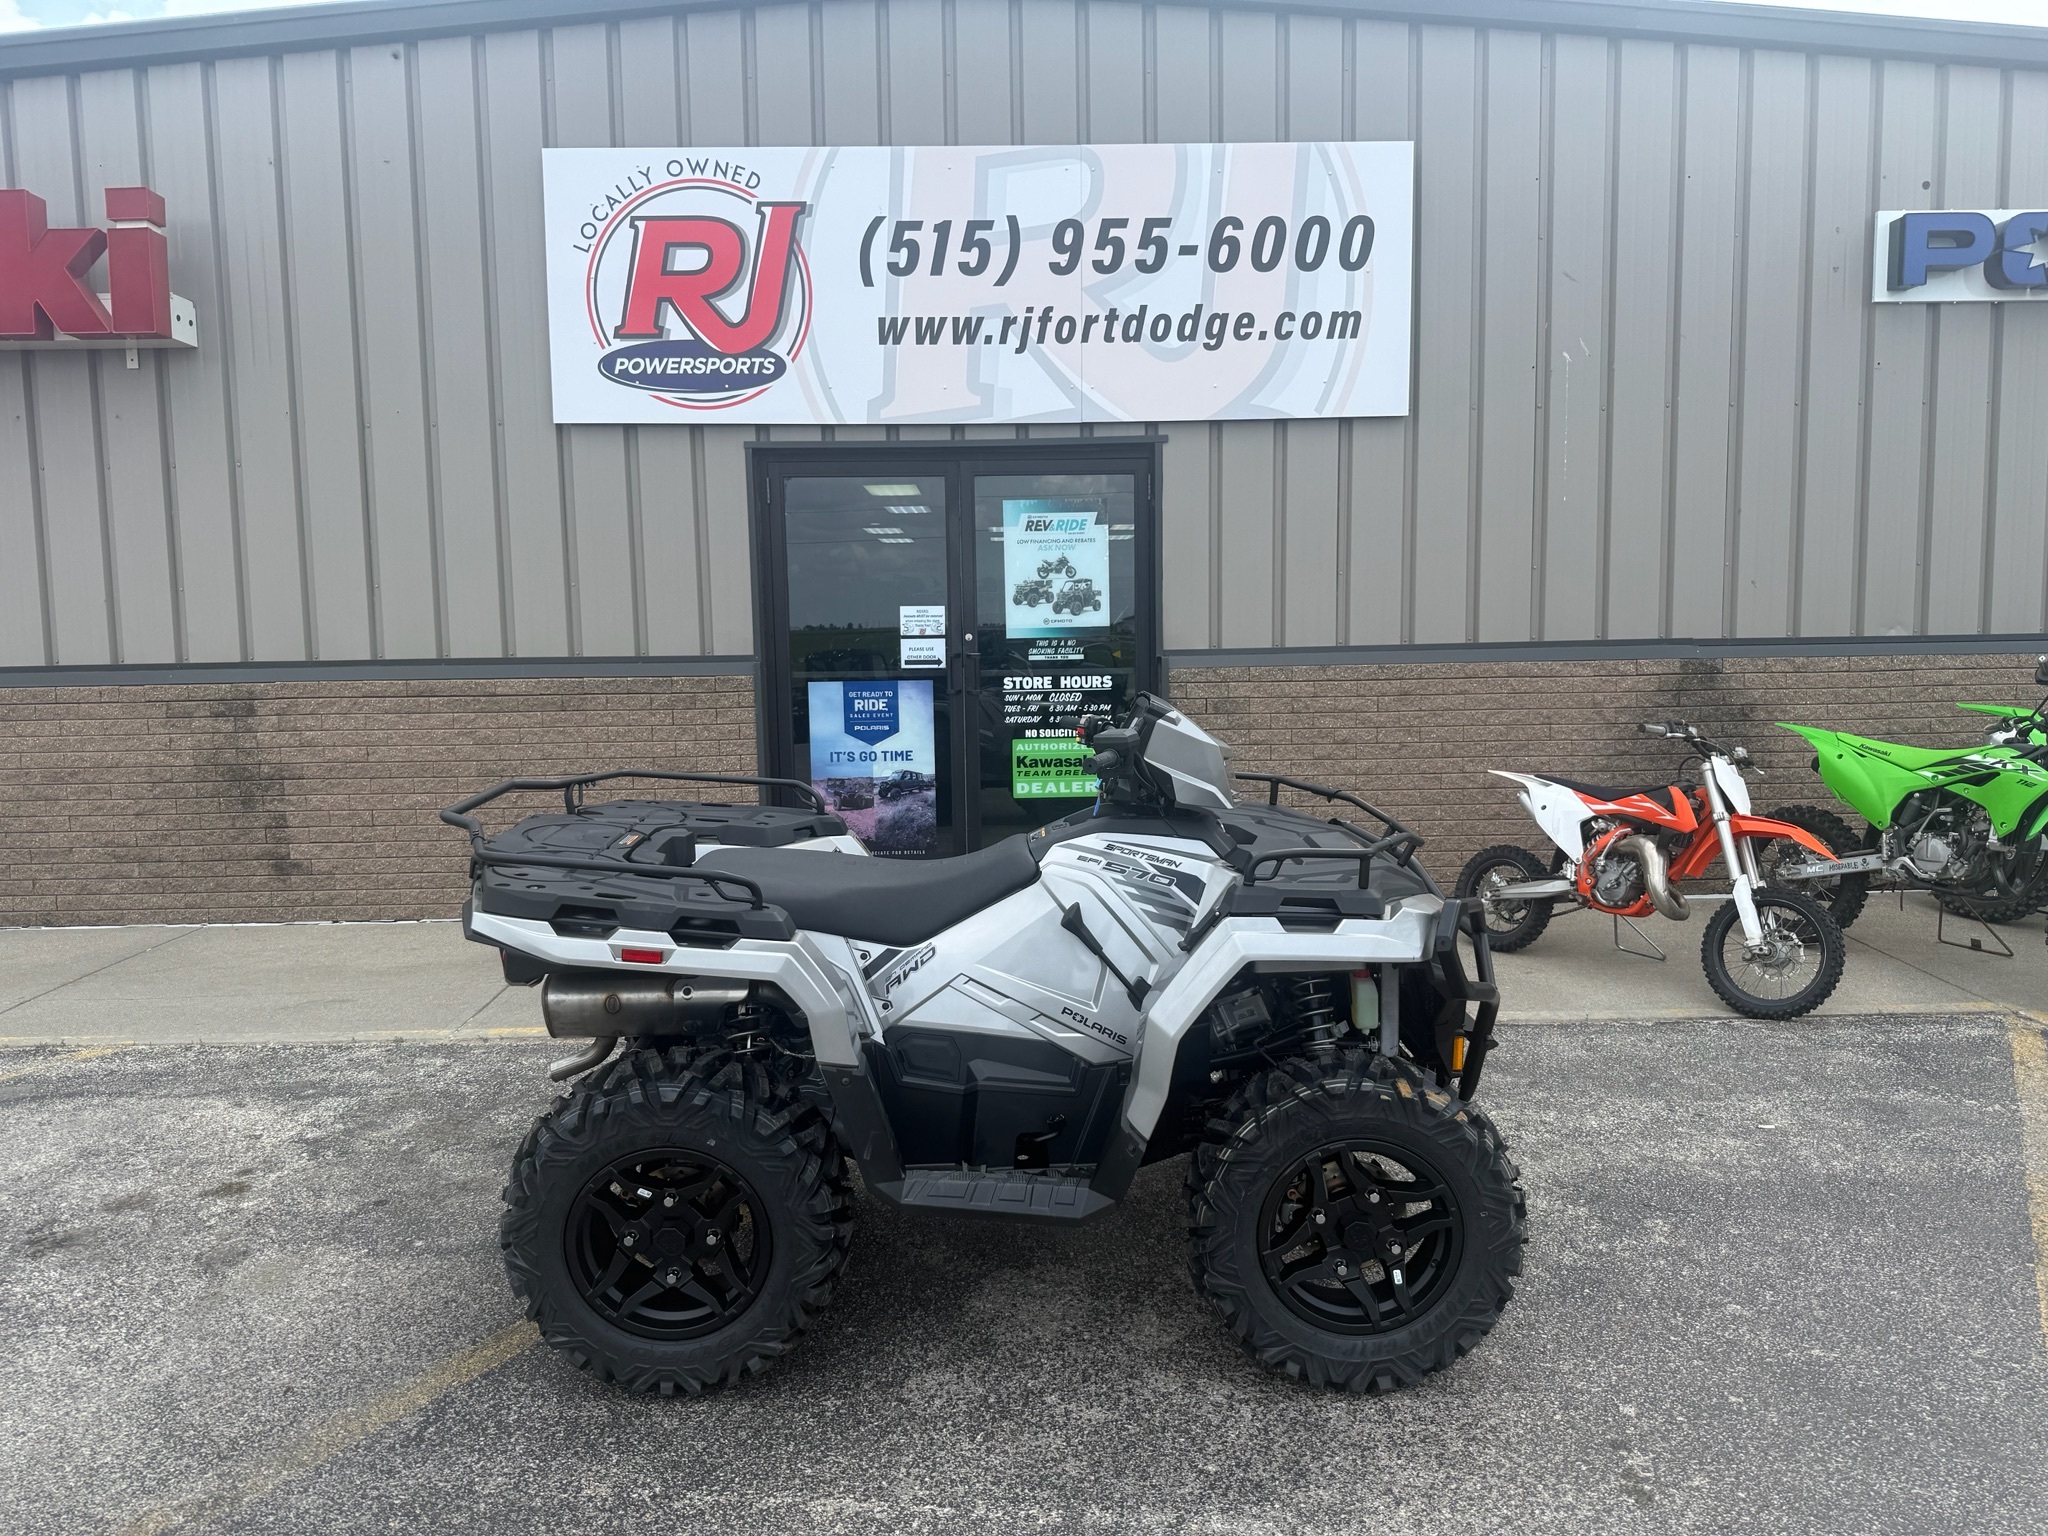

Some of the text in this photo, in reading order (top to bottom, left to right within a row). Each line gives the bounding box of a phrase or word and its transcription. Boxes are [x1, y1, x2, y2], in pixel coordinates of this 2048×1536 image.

[573, 157, 761, 253] LOCALLY OWNED
[859, 214, 1375, 287] (515) 955-6000
[0, 187, 172, 340] ki
[613, 201, 808, 354] RJ
[877, 303, 1362, 354] www.rjfortdodge.com
[613, 357, 776, 376] POWERSPORTS
[1003, 675, 1112, 689] STORE HOURS
[855, 699, 888, 711] RIDE
[1004, 694, 1020, 702] SUN
[1049, 692, 1082, 702] CLOSED
[1025, 729, 1037, 737] NO
[830, 750, 913, 762] IT'S GO TIME
[1859, 743, 1891, 756] Kawasaki
[1016, 755, 1086, 768] Kawasa
[1017, 781, 1098, 794] DEALER
[1104, 843, 1182, 868] SPORTSMAN
[1077, 855, 1176, 887] EFI 570
[885, 946, 936, 995] AWD
[1061, 1006, 1127, 1045] POLARIS
